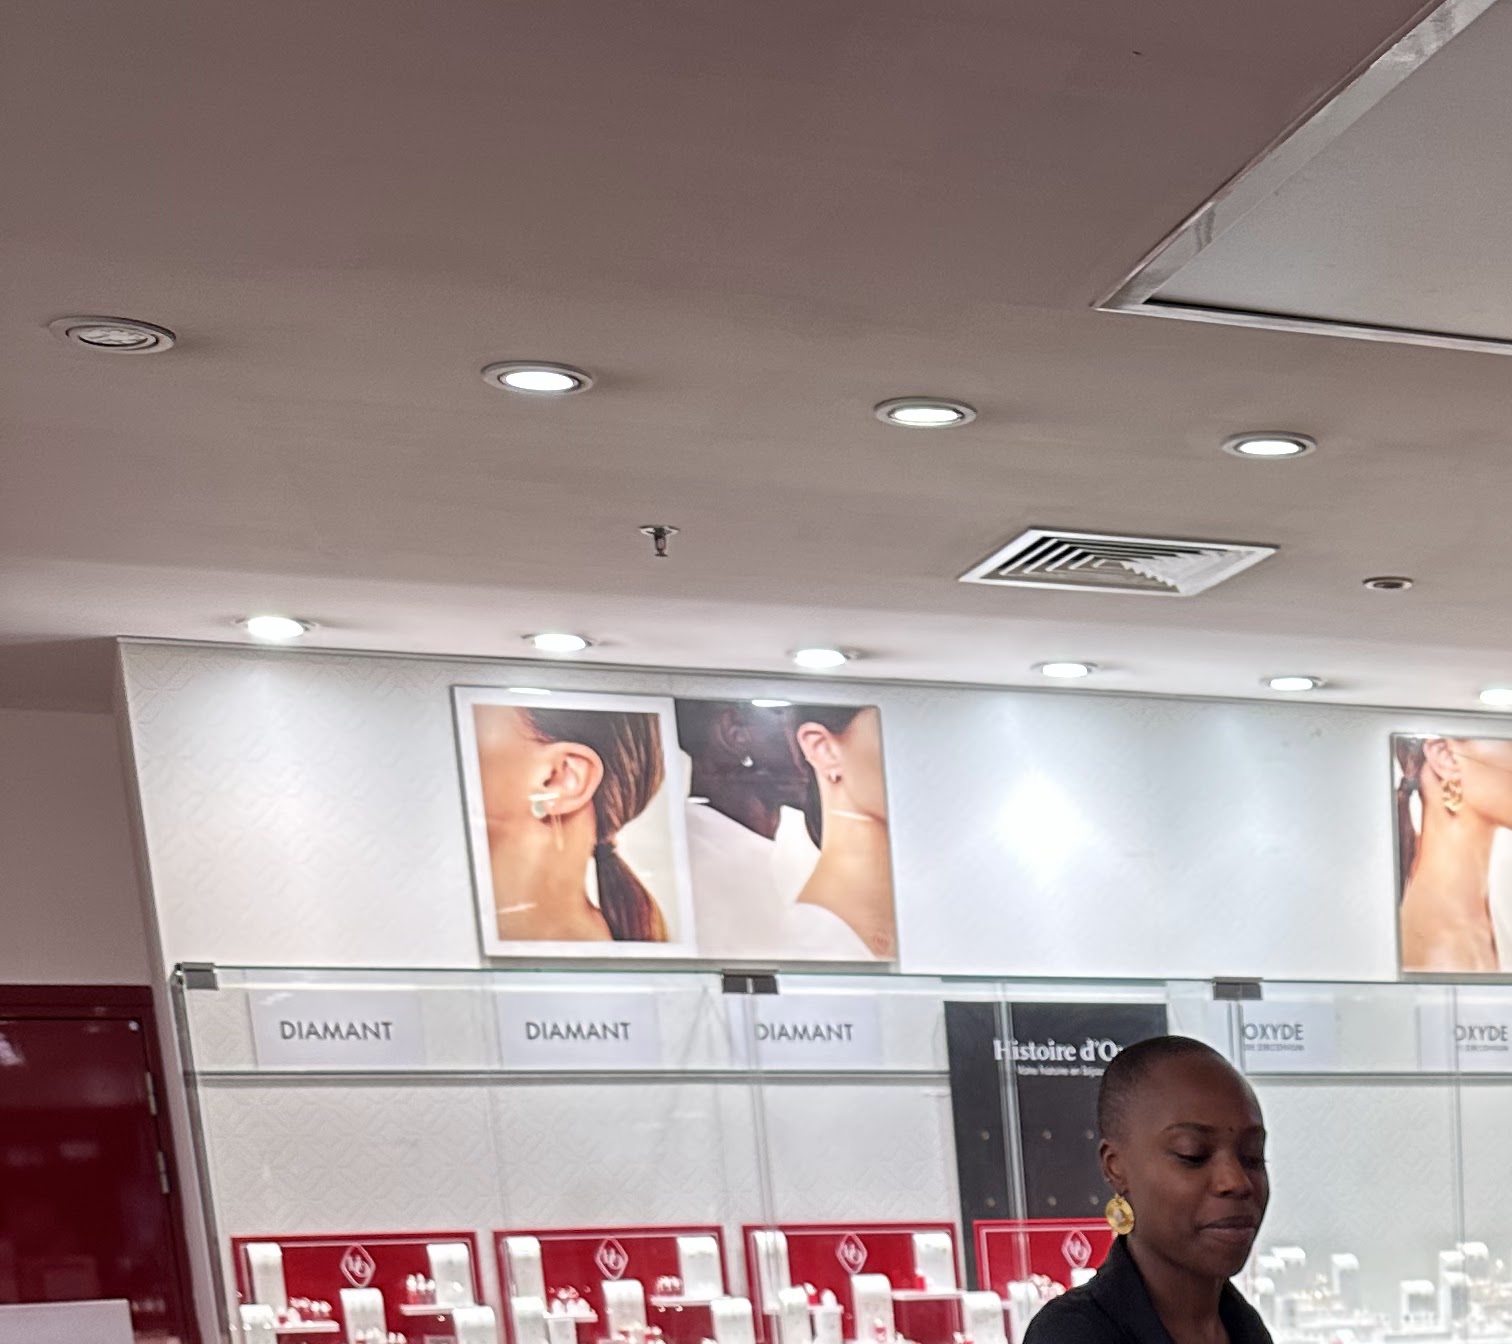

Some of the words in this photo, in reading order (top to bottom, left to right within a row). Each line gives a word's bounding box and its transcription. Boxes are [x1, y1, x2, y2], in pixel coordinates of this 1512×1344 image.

[280, 1020, 392, 1042] DIAMANT
[525, 1020, 631, 1042] DIAMANT
[755, 1022, 854, 1042] DIAMANT
[1242, 1023, 1304, 1040] OXYDE
[993, 1038, 1077, 1061] Histoire
[1079, 1037, 1123, 1062] d'O
